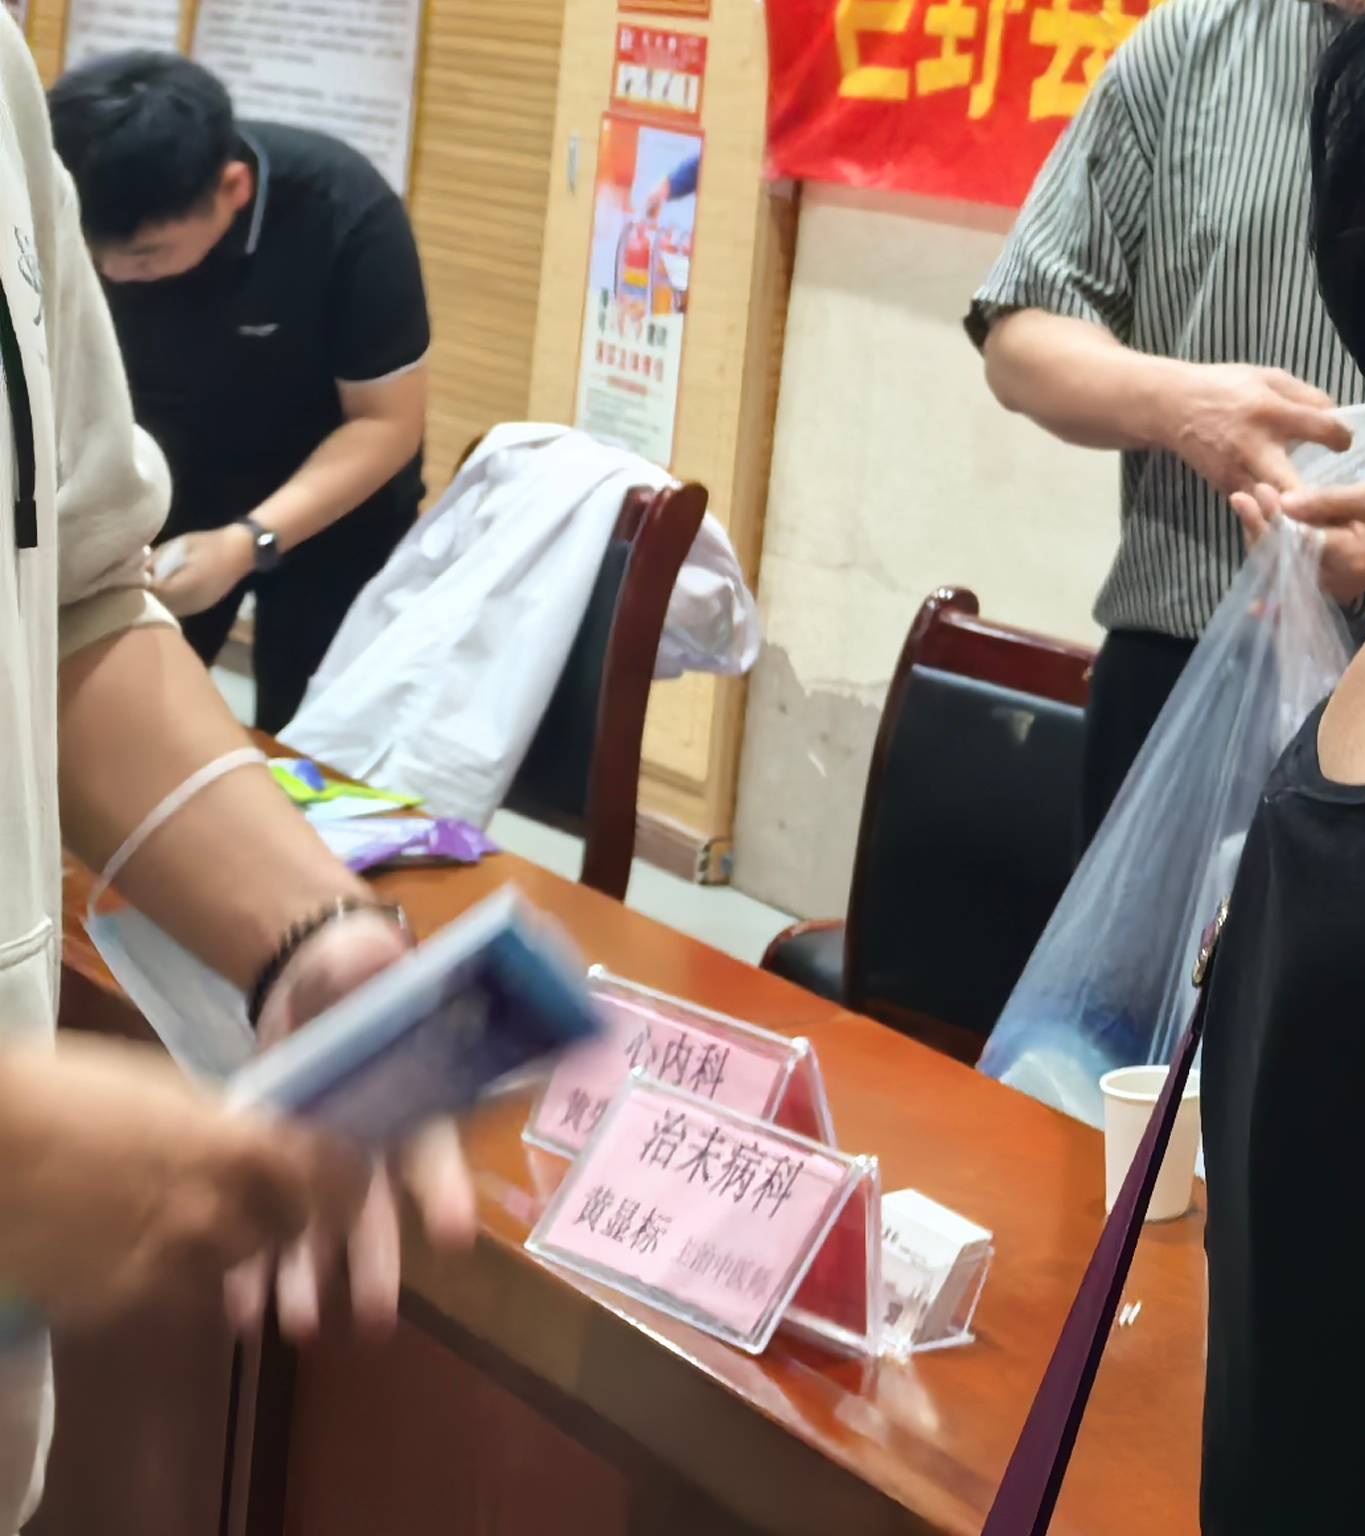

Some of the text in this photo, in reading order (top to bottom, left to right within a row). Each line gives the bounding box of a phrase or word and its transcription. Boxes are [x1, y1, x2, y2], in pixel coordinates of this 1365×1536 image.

[624, 1024, 731, 1100] 心内科
[639, 1108, 805, 1221] 治未病科
